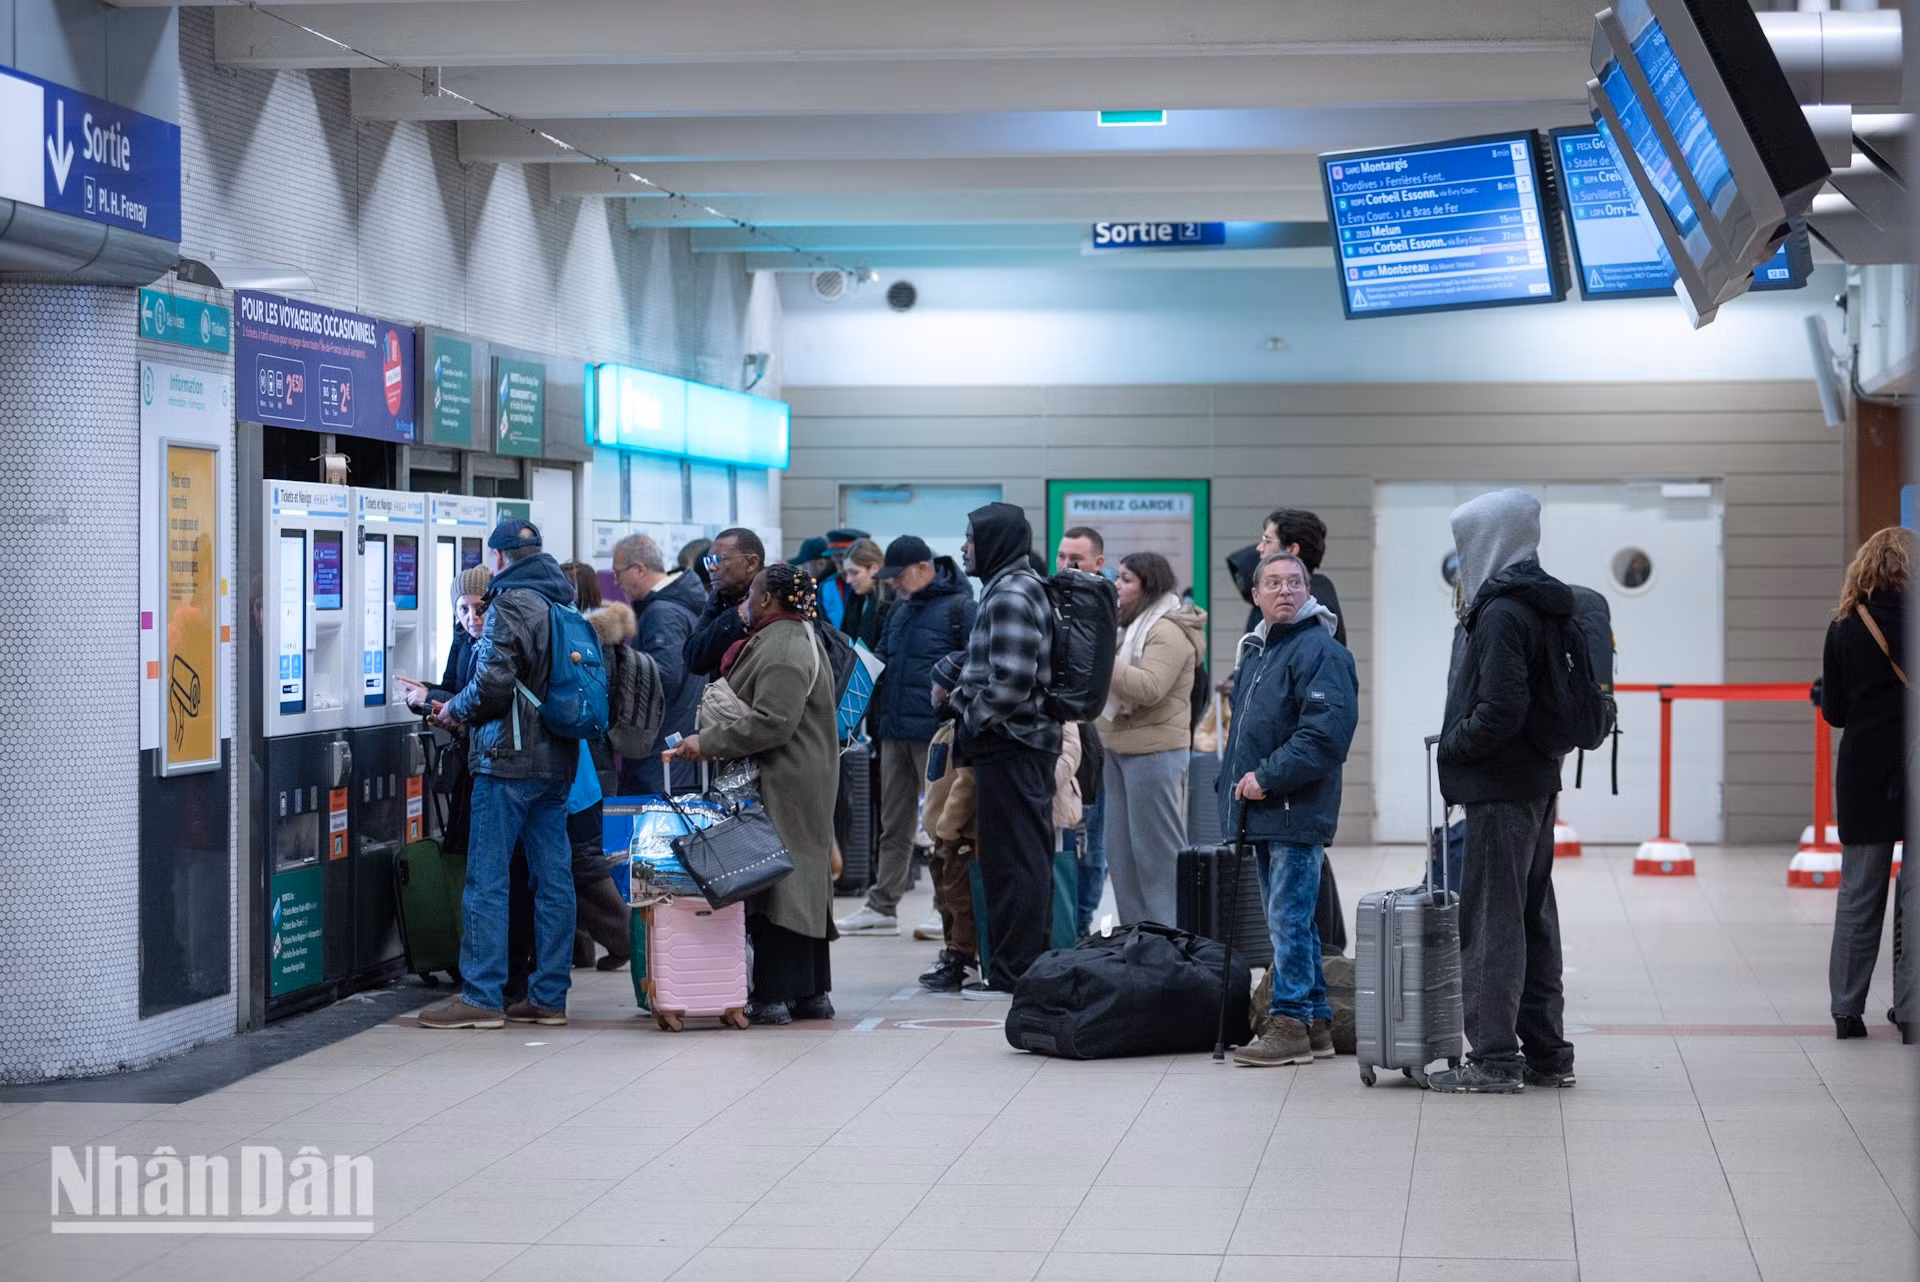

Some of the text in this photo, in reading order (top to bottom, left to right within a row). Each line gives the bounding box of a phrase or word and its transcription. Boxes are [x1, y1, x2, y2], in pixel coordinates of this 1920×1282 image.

[83, 112, 131, 172] Sortie
[1566, 144, 1572, 153] D
[1360, 158, 1408, 173] Montargis
[1573, 156, 1611, 169] Stade de
[1341, 172, 1446, 192] Dordives Ferrières Font.
[1572, 177, 1579, 186] D
[1365, 191, 1401, 206] Corbeil
[1401, 189, 1439, 201] Essonn.
[1580, 188, 1621, 201] Survilliers
[87, 184, 148, 229] 9 Pl. H. Frenay
[1347, 202, 1459, 224] Évry Courc. Le Bras de Fer
[1095, 221, 1195, 244] Sortie 2
[1371, 225, 1402, 238] Melun
[1373, 239, 1409, 254] Corbeil
[1409, 238, 1448, 250] Essonn.
[1377, 263, 1430, 277] Montereau
[241, 296, 377, 348] POUR LES VOYAGEURS OCCASIONNELS,
[280, 488, 294, 505] Tickets
[1073, 499, 1125, 511] PRENEZ
[1128, 499, 1175, 511] GARDE
